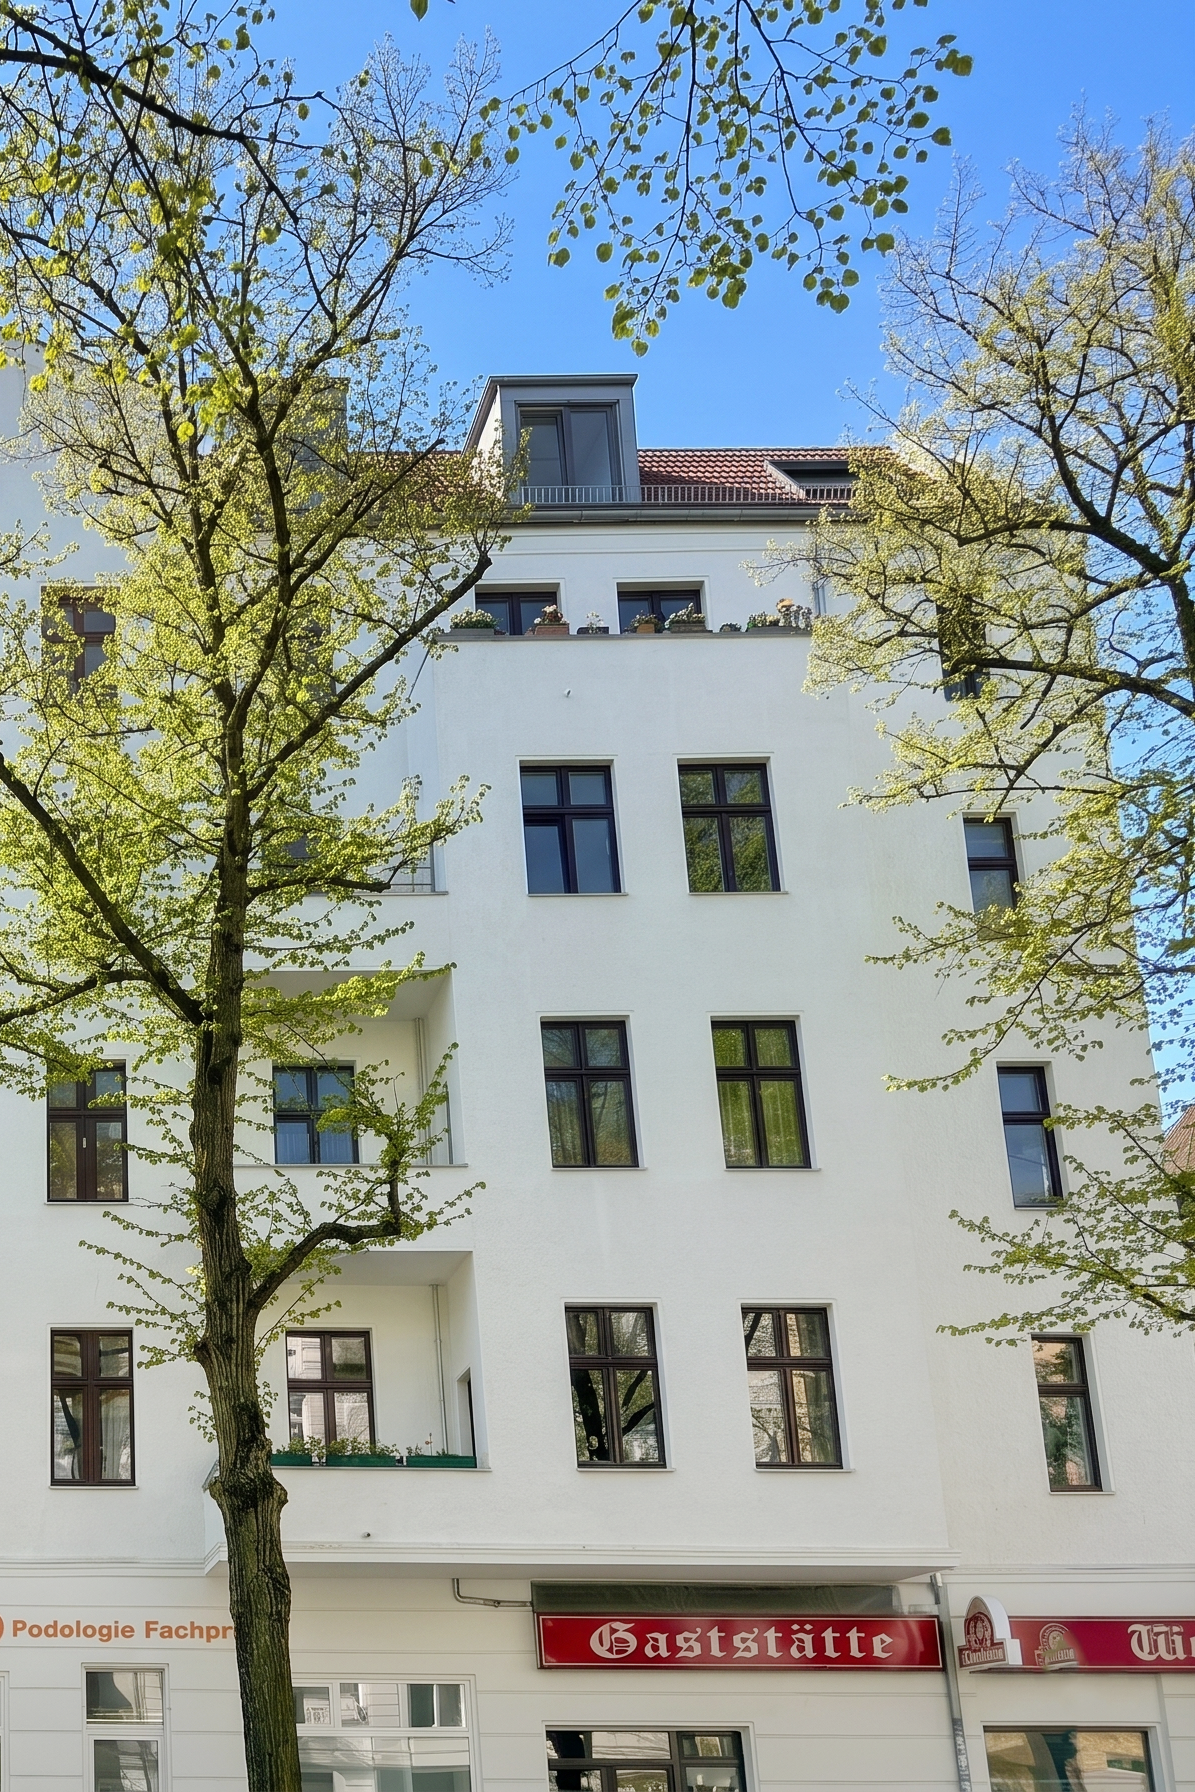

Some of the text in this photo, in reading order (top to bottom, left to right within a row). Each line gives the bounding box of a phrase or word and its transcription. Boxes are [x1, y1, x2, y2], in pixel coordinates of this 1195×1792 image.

[12, 1620, 235, 1643] Podologie Fachpr
[589, 1621, 894, 1659] Gaststätte
